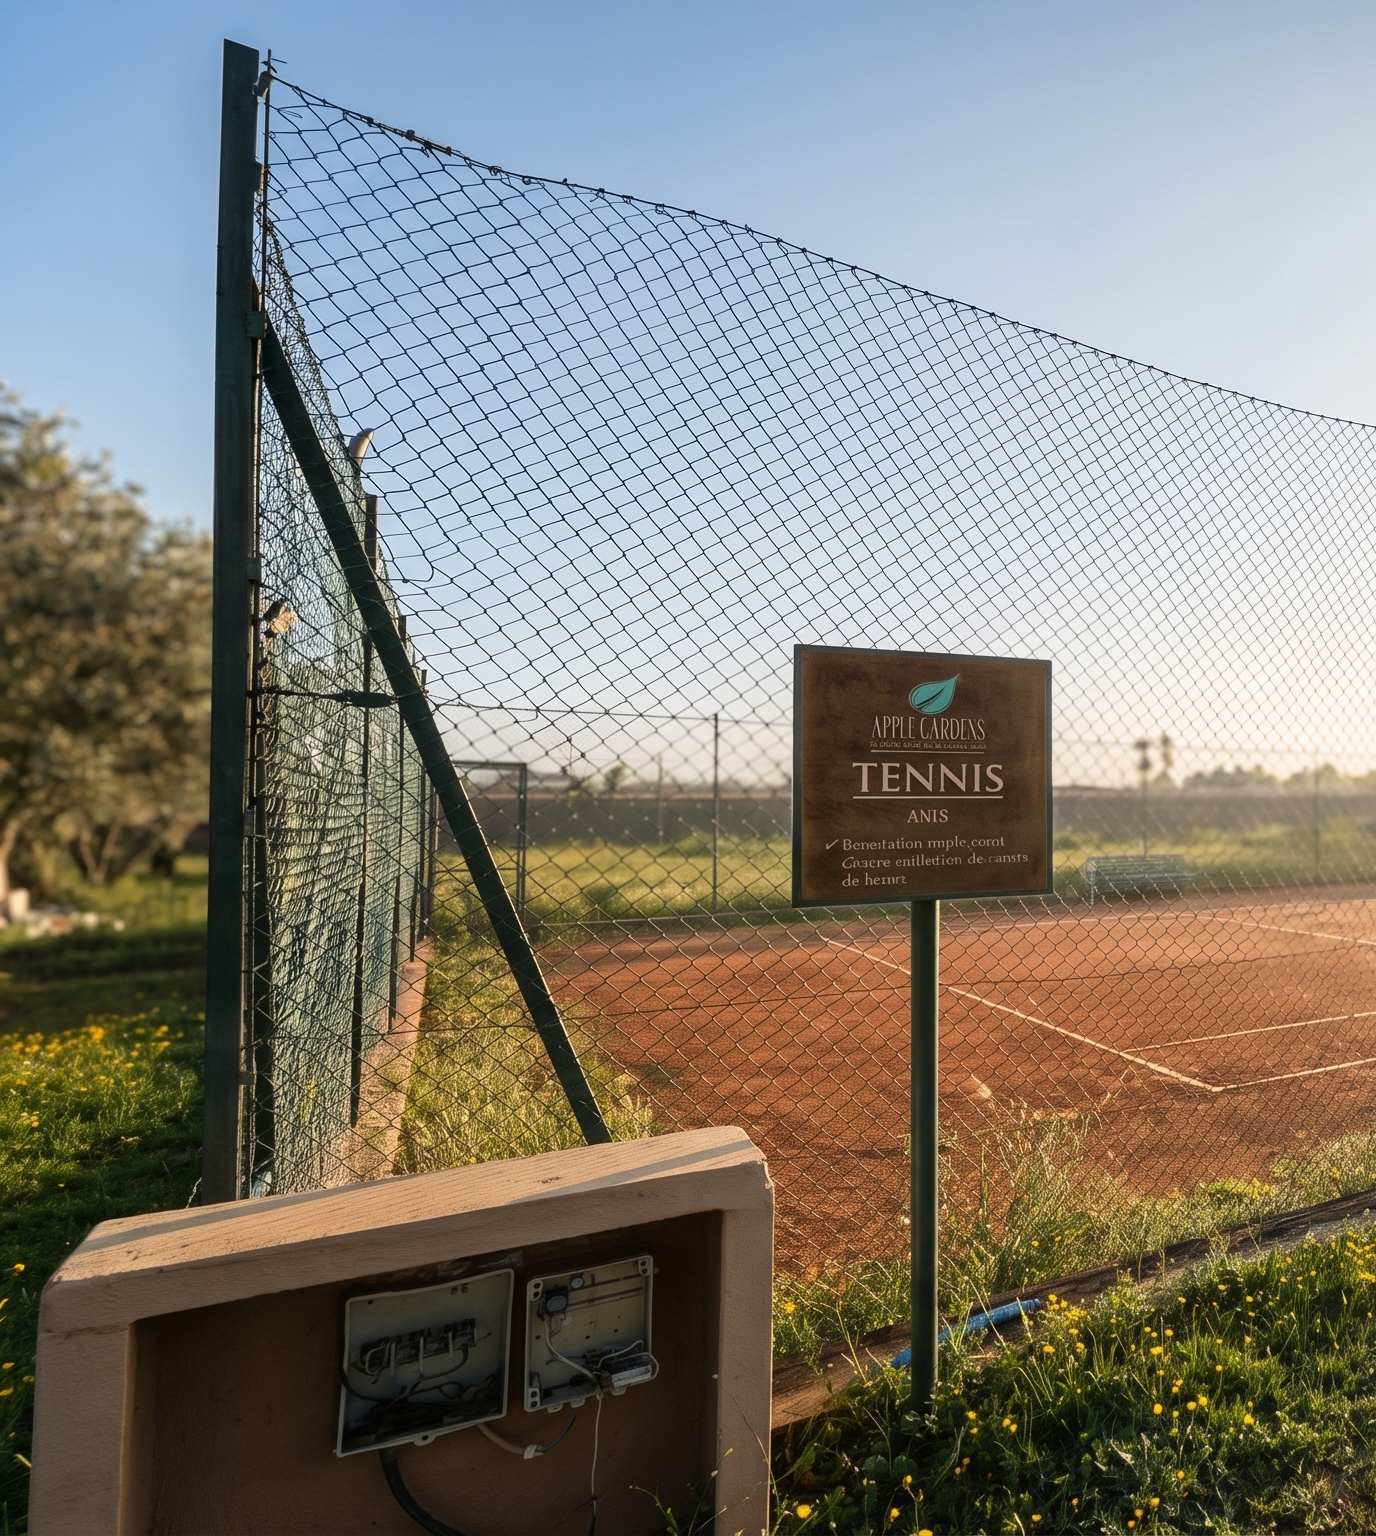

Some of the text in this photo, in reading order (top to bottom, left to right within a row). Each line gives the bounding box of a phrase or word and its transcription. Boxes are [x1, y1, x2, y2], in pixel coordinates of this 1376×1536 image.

[871, 715, 915, 739] APPLE
[852, 762, 1004, 793] TENNIS
[907, 809, 949, 823] ANIS
[841, 873, 859, 887] de
